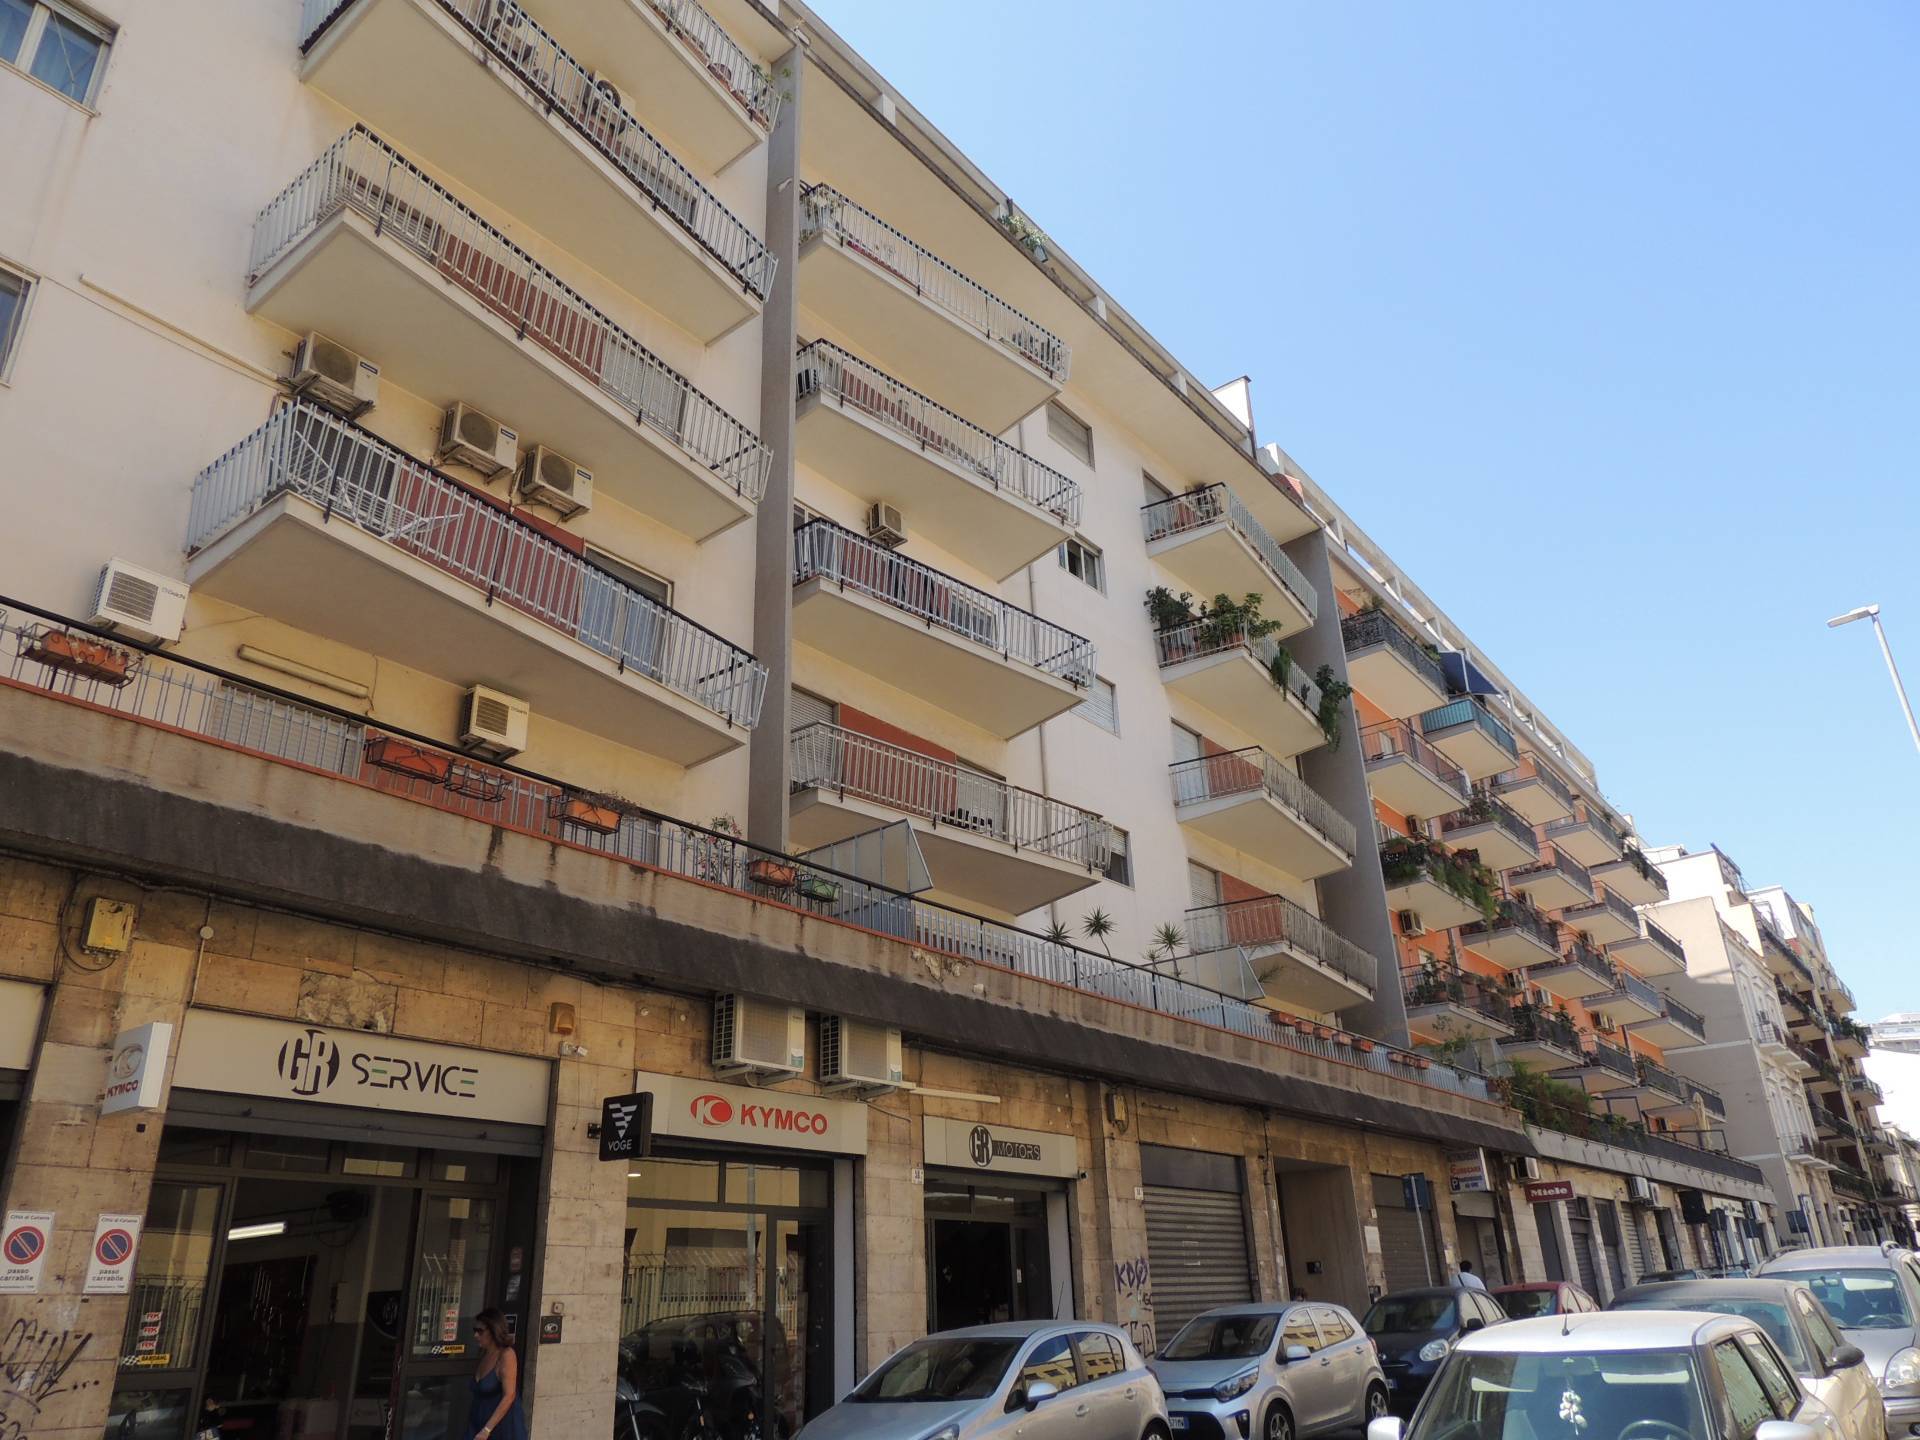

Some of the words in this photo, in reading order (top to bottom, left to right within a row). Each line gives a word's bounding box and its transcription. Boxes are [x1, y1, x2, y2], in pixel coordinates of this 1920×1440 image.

[351, 1053, 479, 1098] SERVICE
[740, 1103, 828, 1135] KYMCO
[608, 1139, 633, 1152] VOGE
[997, 1142, 1041, 1160] MOTORS
[1530, 1186, 1568, 1197] Miele
